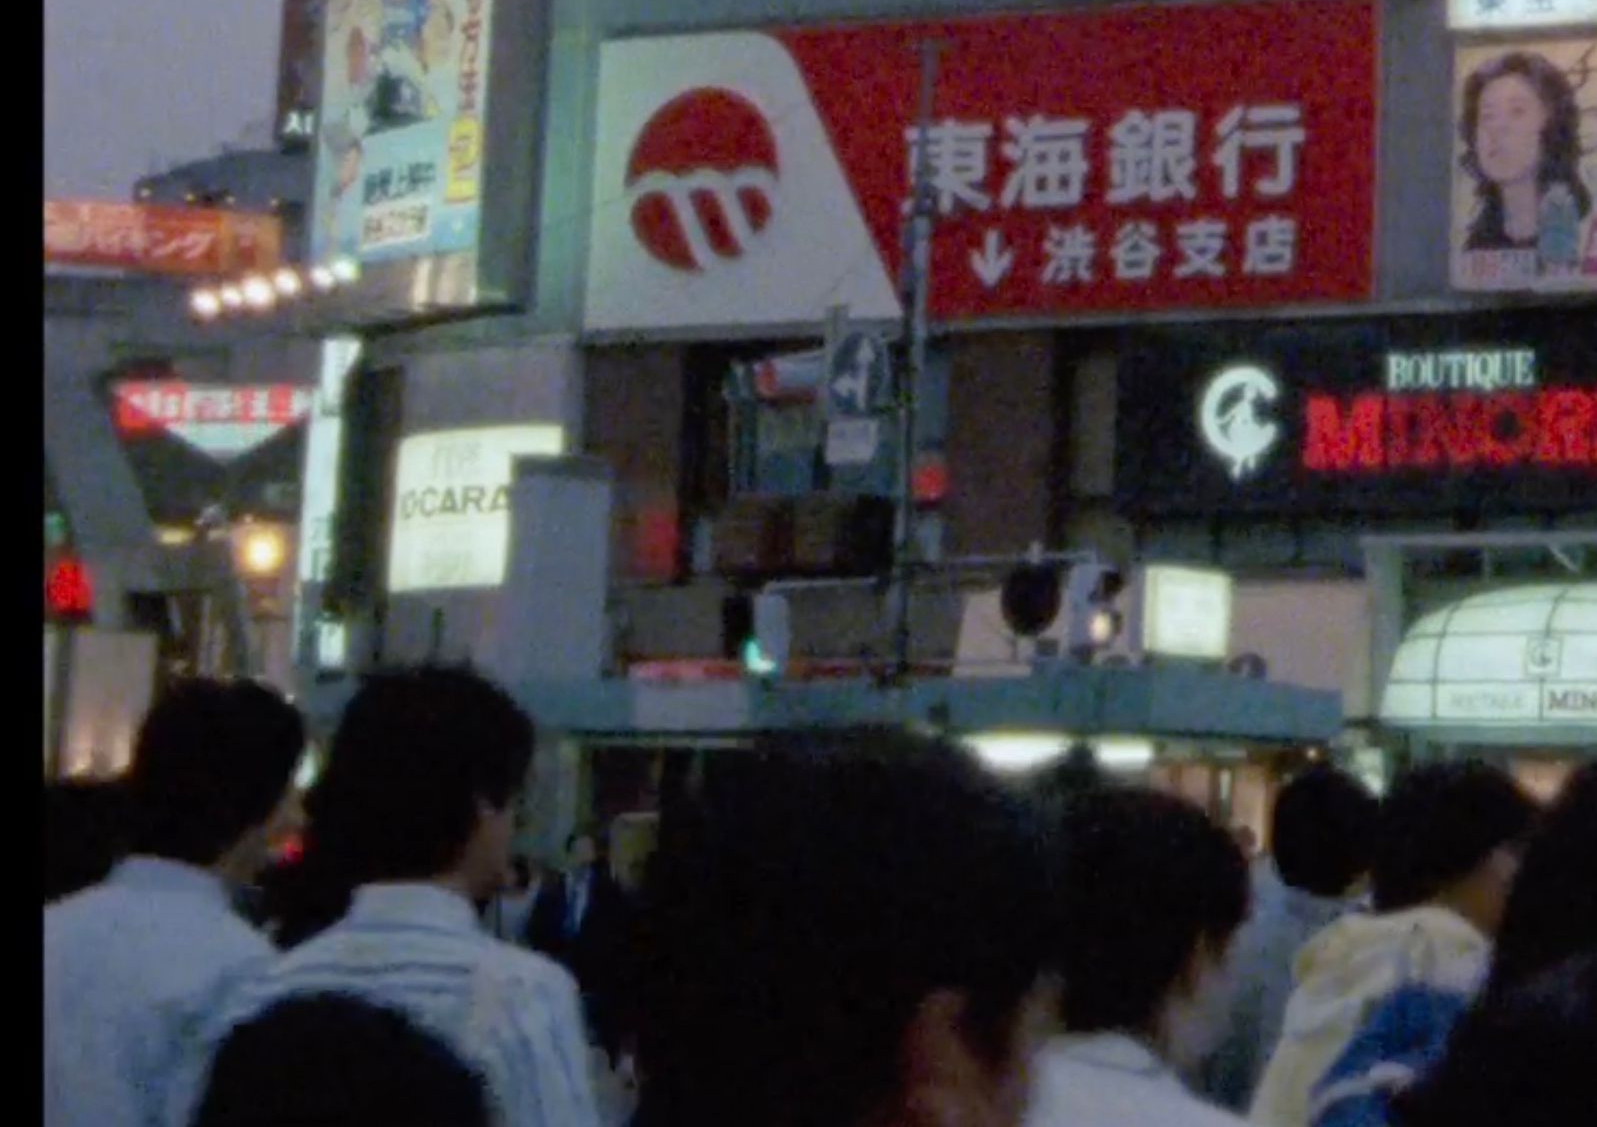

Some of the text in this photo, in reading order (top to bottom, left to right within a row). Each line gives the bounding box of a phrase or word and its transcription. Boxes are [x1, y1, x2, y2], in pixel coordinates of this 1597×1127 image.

[901, 103, 1308, 215] 東海銀行
[1041, 215, 1297, 284] 渋谷支店
[1386, 348, 1536, 390] BOUTIQUE
